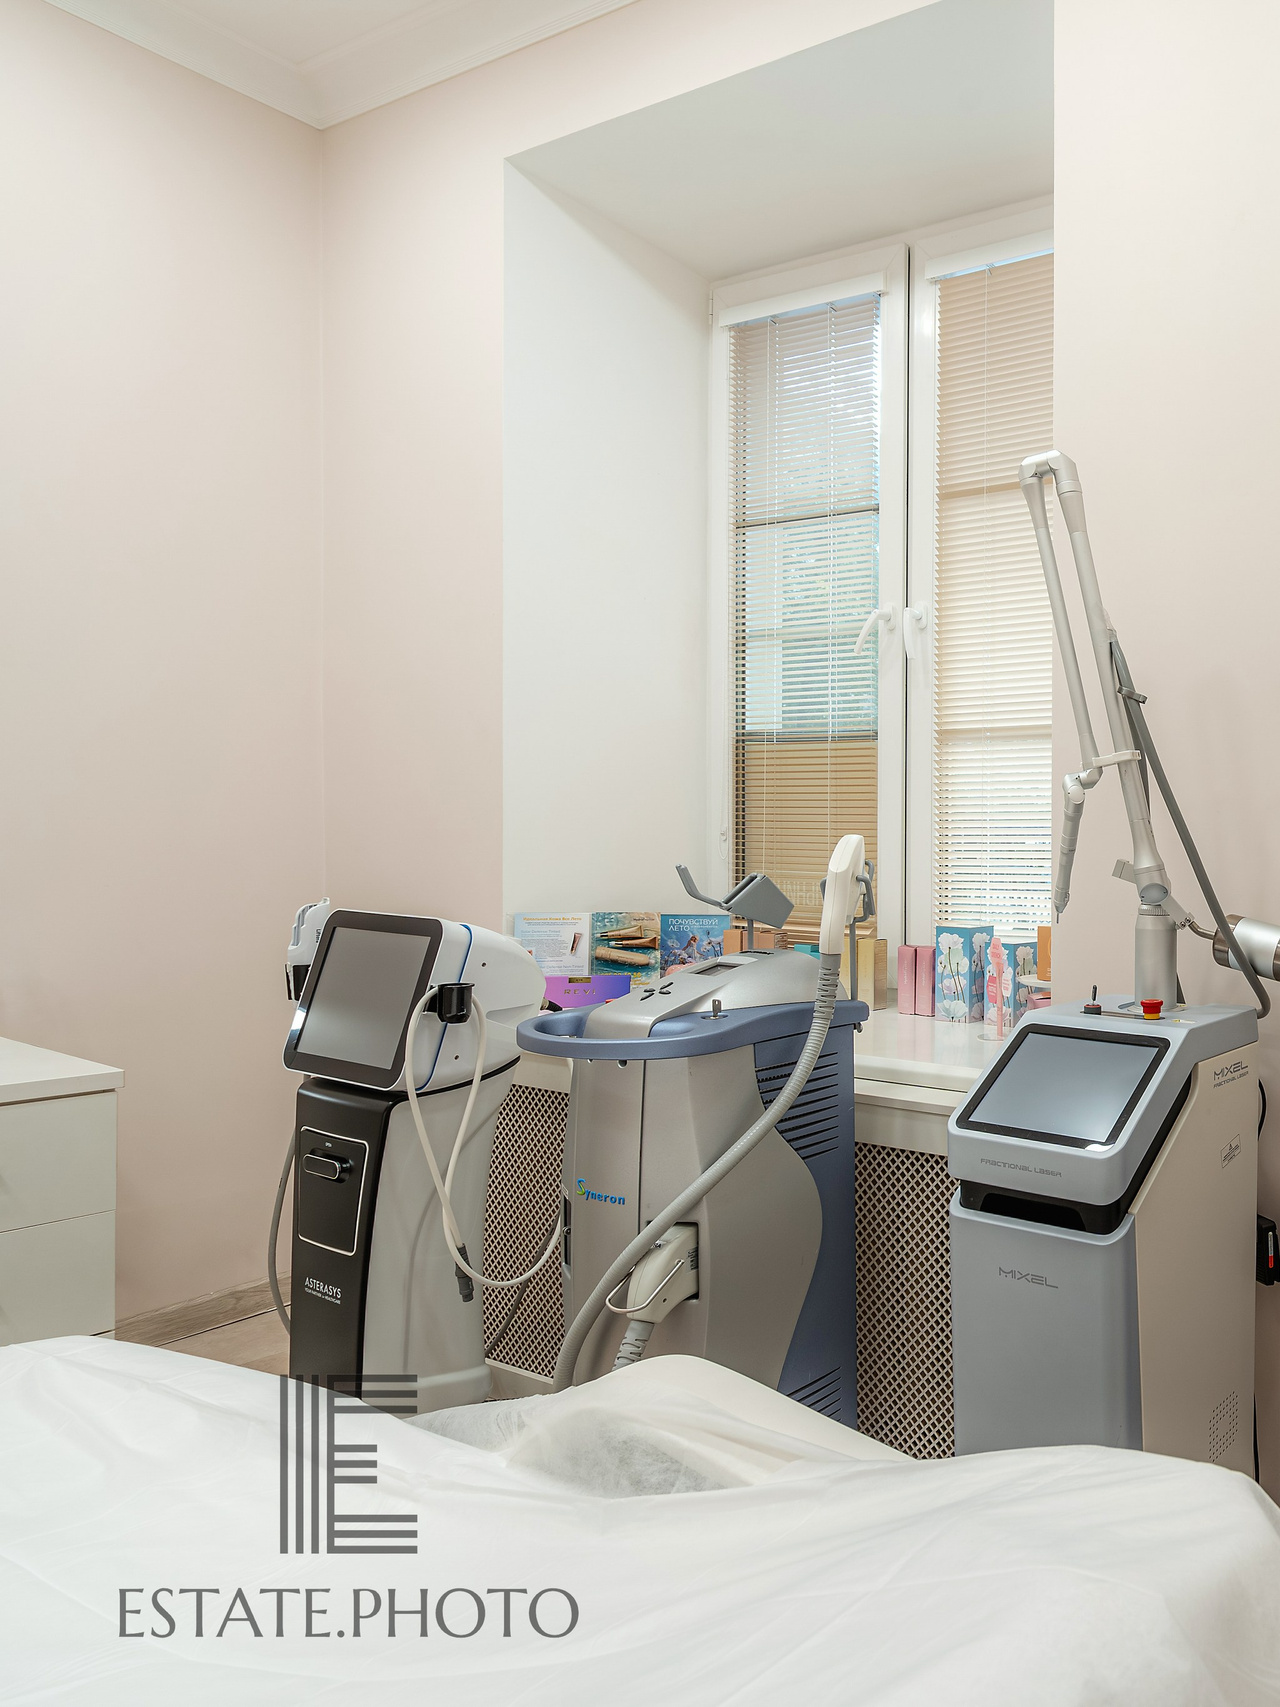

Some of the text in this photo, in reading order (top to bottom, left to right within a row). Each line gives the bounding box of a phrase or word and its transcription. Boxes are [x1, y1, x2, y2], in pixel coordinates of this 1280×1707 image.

[1213, 1061, 1249, 1080] MIXEL
[577, 1178, 625, 1205] Syneron
[304, 1276, 342, 1298] ASTERASYS
[999, 1266, 1058, 1289] MIXEL
